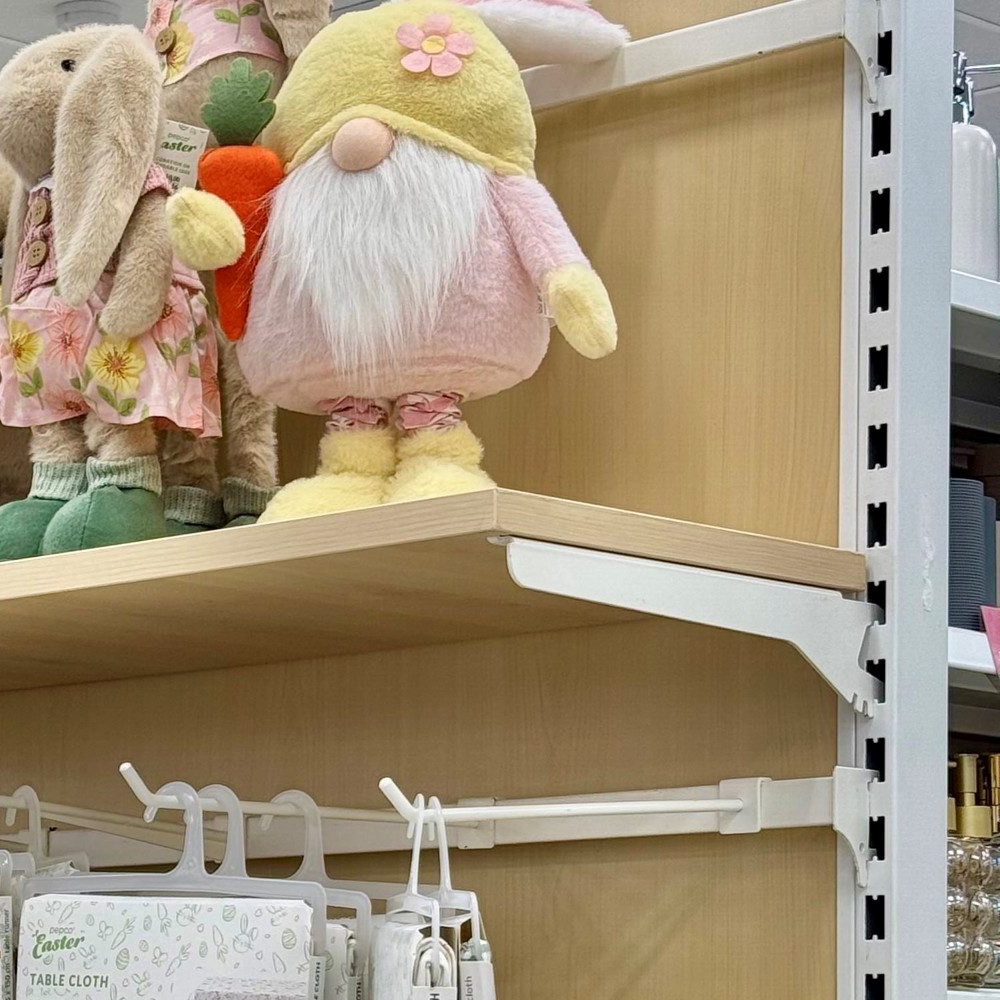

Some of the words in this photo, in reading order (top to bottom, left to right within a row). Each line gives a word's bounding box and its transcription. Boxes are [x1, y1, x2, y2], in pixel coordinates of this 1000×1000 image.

[160, 141, 197, 153] aster
[49, 927, 74, 936] pepco
[32, 930, 85, 959] Easter
[30, 973, 65, 986] TABLE
[69, 975, 108, 988] CLOTH
